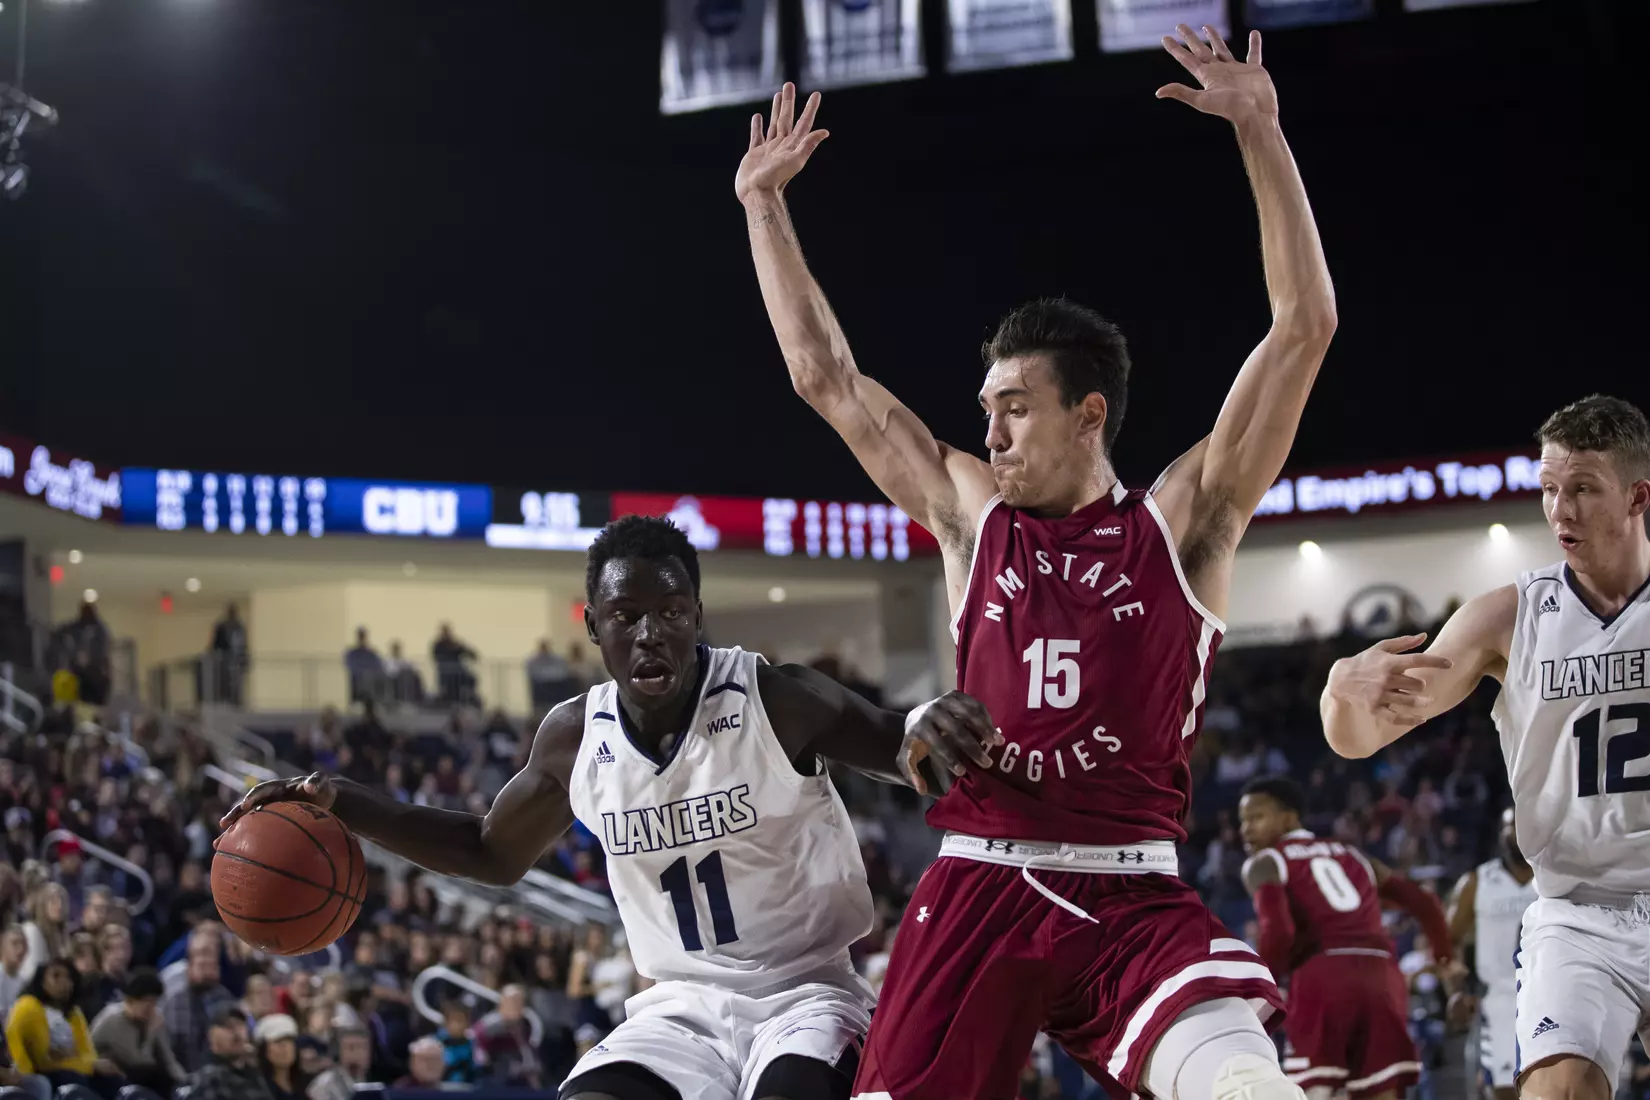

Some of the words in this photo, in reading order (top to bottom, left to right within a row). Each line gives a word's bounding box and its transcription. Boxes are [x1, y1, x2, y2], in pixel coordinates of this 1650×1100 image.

[1436, 462, 1503, 501] Top
[1093, 526, 1122, 536] WAC
[984, 566, 1025, 622] NM
[1035, 550, 1145, 622] STATE
[1540, 606, 1560, 616] didas
[1023, 637, 1081, 709] 15
[1541, 648, 1650, 701] LANCE
[706, 713, 741, 736] WAC
[1573, 702, 1650, 797] 12
[597, 755, 616, 764] didas
[601, 784, 757, 855] LANCERS
[660, 850, 739, 951] 11
[1310, 857, 1361, 912] 0
[1532, 1023, 1560, 1039] adidas
